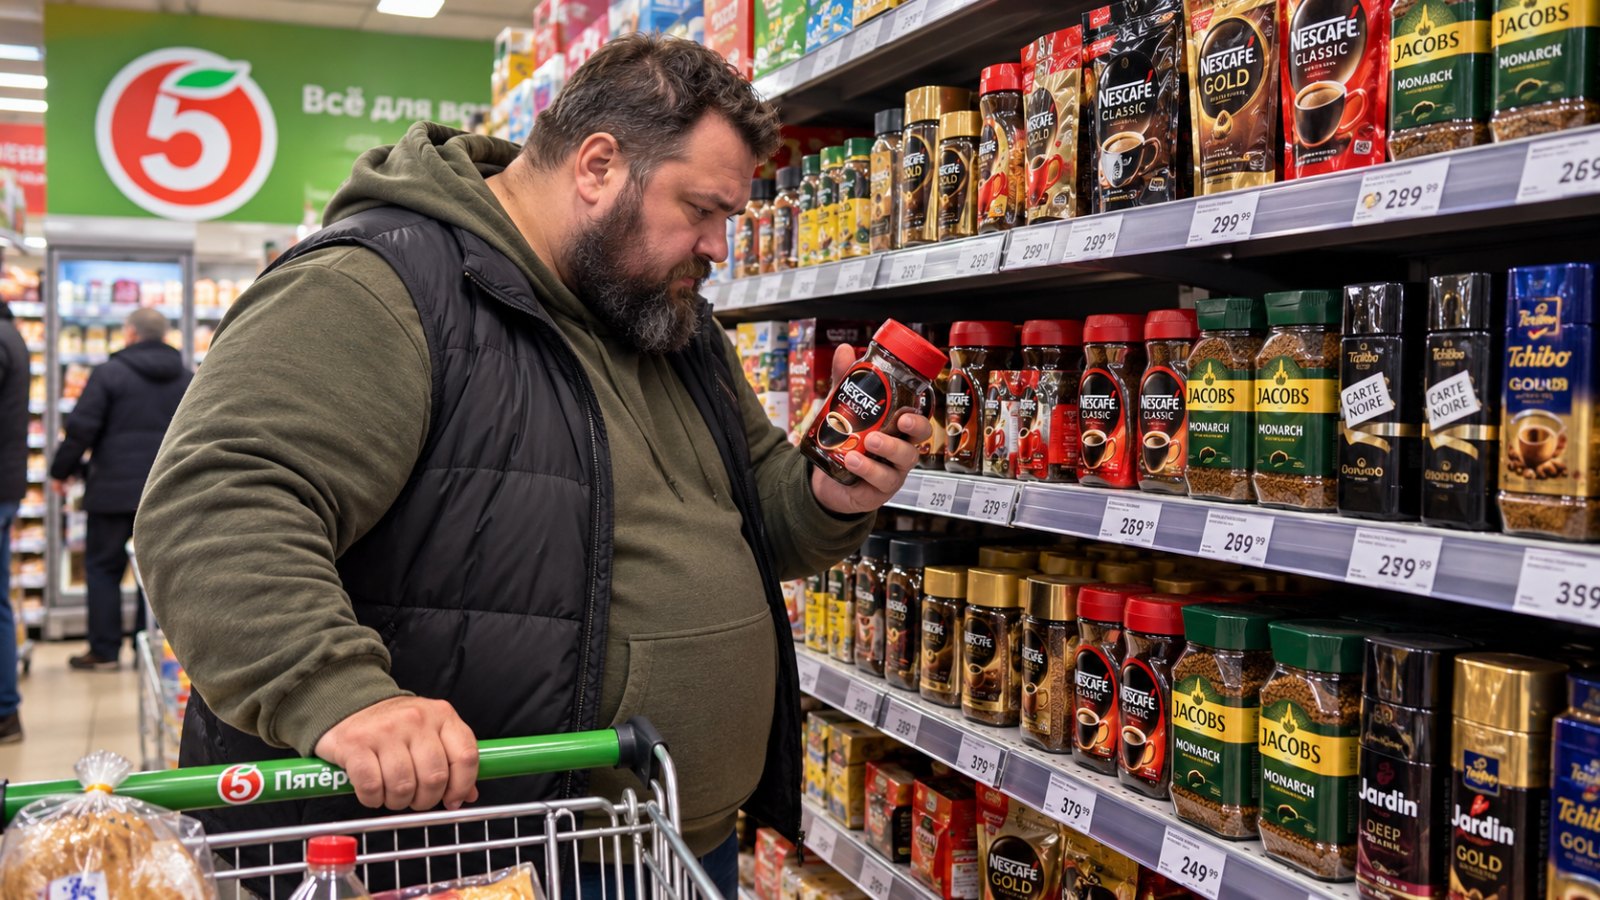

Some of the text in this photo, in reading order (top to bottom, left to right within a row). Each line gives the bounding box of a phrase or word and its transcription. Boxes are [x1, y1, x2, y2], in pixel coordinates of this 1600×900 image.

[1497, 3, 1570, 39] JACOBS
[1295, 42, 1348, 67] CLASSIC
[1393, 30, 1460, 63] JACOBS
[1499, 43, 1563, 69] MONARCH
[1204, 69, 1250, 96] GOLD
[1397, 69, 1454, 91] MONARCH
[302, 84, 492, 123] Всё для вс
[1101, 102, 1147, 122] CLASSIC
[140, 92, 232, 192] 5
[1211, 215, 1240, 234] 299
[1083, 233, 1107, 252] 299
[1508, 344, 1572, 367] Tchibo
[1187, 387, 1235, 405] JACOBS
[1256, 387, 1310, 405] JACOBS
[1346, 381, 1381, 406] CARTE
[1430, 381, 1465, 406] CARTE
[1143, 410, 1174, 421] CLASSIC
[1349, 394, 1385, 419] NOIRE
[1432, 395, 1470, 420] NOIRE
[1189, 422, 1230, 433] MONARCH
[1258, 424, 1303, 437] MONARCH
[1145, 520, 1155, 530] 99
[1255, 536, 1266, 546] 99
[1173, 699, 1226, 733] JACOBS
[1175, 737, 1221, 764] MONARCH
[1261, 727, 1321, 765] JACOBS
[971, 755, 989, 773] 379
[229, 774, 252, 799] 5
[1263, 767, 1315, 799] MONARCH
[1060, 797, 1082, 819] 379
[1358, 777, 1418, 818] Jardin
[1366, 818, 1401, 842] DEEP
[1451, 804, 1514, 846] Jardin
[1180, 855, 1219, 883] 249 99
[1456, 845, 1502, 873] GOLD
[991, 871, 1033, 894] GOLD
